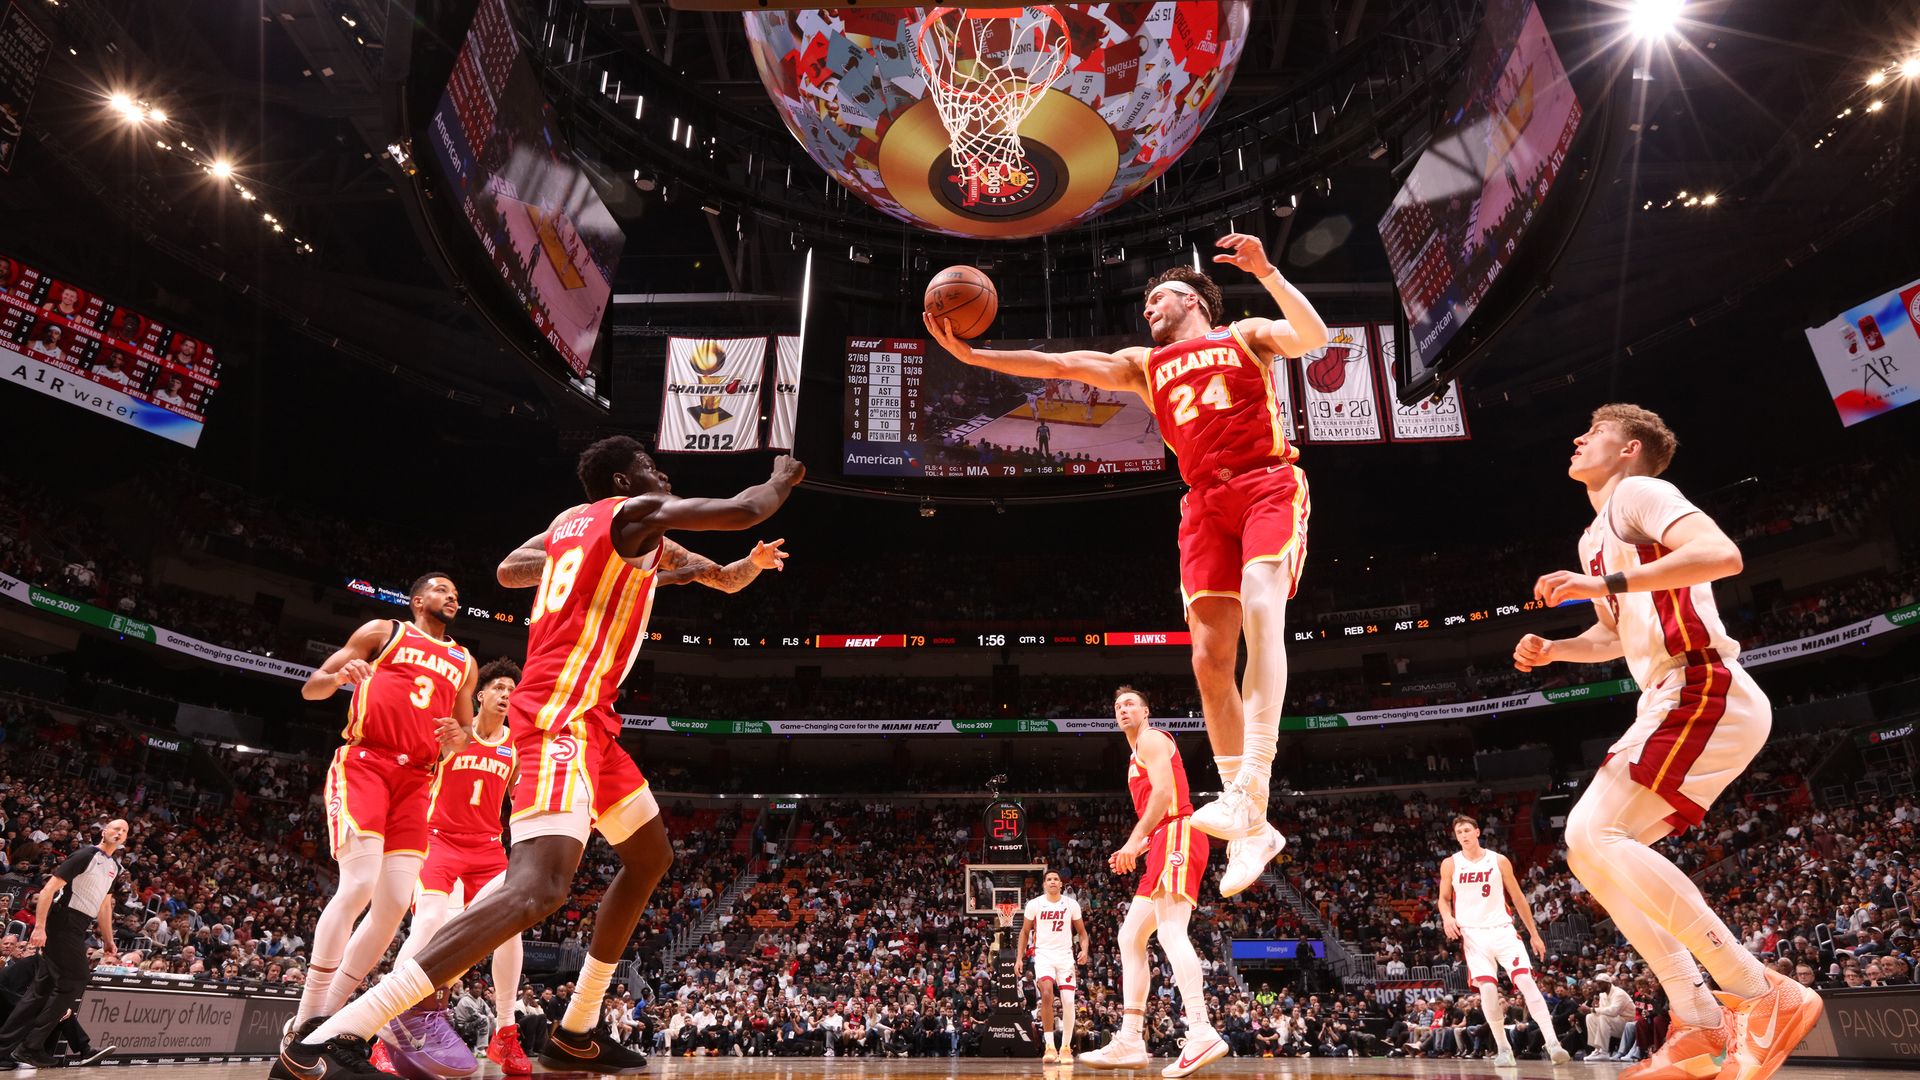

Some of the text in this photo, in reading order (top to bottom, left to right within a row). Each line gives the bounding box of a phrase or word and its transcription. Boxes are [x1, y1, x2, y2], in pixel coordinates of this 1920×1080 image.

[1107, 59, 1137, 75] STRONG
[1122, 102, 1144, 128] STRONG
[435, 112, 461, 172] American
[1551, 149, 1565, 176] ATL
[1540, 178, 1548, 196] 90
[483, 233, 496, 259] MIA
[1487, 260, 1502, 283] MIA
[535, 312, 543, 327] 90
[1420, 311, 1453, 353] American
[547, 330, 560, 351] ATL
[851, 340, 882, 348] HEAT
[848, 354, 868, 362] 27/66
[903, 356, 923, 364] 35/73
[850, 365, 865, 373] 7/23
[904, 367, 922, 375] 13/36
[1155, 347, 1243, 393] ATLANTA
[848, 376, 867, 384] 18/20
[907, 378, 919, 386] 7/11
[854, 387, 861, 395] 17
[908, 389, 917, 397] 22
[1169, 373, 1233, 426] 24
[74, 388, 139, 420] water
[871, 398, 885, 406] OFF
[1311, 399, 1372, 418] 19 20
[1436, 397, 1456, 414] 23
[909, 411, 916, 419] 10
[851, 432, 861, 440] 40
[908, 434, 917, 442] 42
[1313, 427, 1375, 437] CHAMPIONS
[1398, 424, 1460, 434] CHAMPIONS
[685, 434, 734, 450] 2012
[847, 453, 902, 464] American
[967, 466, 1016, 476] MIA 79
[1073, 463, 1120, 473] 90 ATL
[552, 517, 594, 545] GUEYE
[32, 592, 80, 613] Since 2007
[1470, 600, 1544, 621] 36.1 FG% 47.9
[468, 607, 514, 622] FG% 40.9
[1892, 610, 1917, 624] Since
[124, 627, 145, 639] Health
[126, 619, 149, 631] Baptist
[1344, 616, 1465, 635] REB 34 AST 22 3P%
[683, 635, 700, 644] BLK
[733, 638, 750, 646] TOL
[782, 637, 799, 646] FLS
[804, 637, 810, 646] 4
[845, 636, 882, 647] HEAT
[910, 636, 925, 646] 79
[977, 634, 1005, 647] 1:56
[1019, 636, 1036, 644] QTR
[1039, 636, 1045, 644] 3
[1085, 634, 1100, 645] 90
[1134, 634, 1166, 644] HAWKS
[1295, 632, 1313, 641] BLK
[1746, 620, 1873, 662] Care for the MIAMI HEAT
[167, 635, 282, 670] Game-Changing Care for the
[392, 646, 464, 691] ATLANTA
[409, 675, 437, 710] 3
[1356, 687, 1590, 721] Game-Changing Care for the MIAMI HEAT Since 2007
[914, 721, 942, 730] HEAT
[1066, 721, 1119, 730] Game-Changin
[470, 779, 483, 806] 1
[1001, 809, 1018, 819] 1:56
[993, 820, 1017, 838] 24
[1459, 868, 1493, 883] HEAT
[1482, 884, 1491, 897] 9
[1040, 908, 1067, 920] HEAT
[1052, 920, 1064, 932] 12
[1375, 987, 1445, 1004] HOT SEATS
[89, 999, 231, 1030] The Luxury of More
[99, 1032, 211, 1048] PanoramaTower.com
